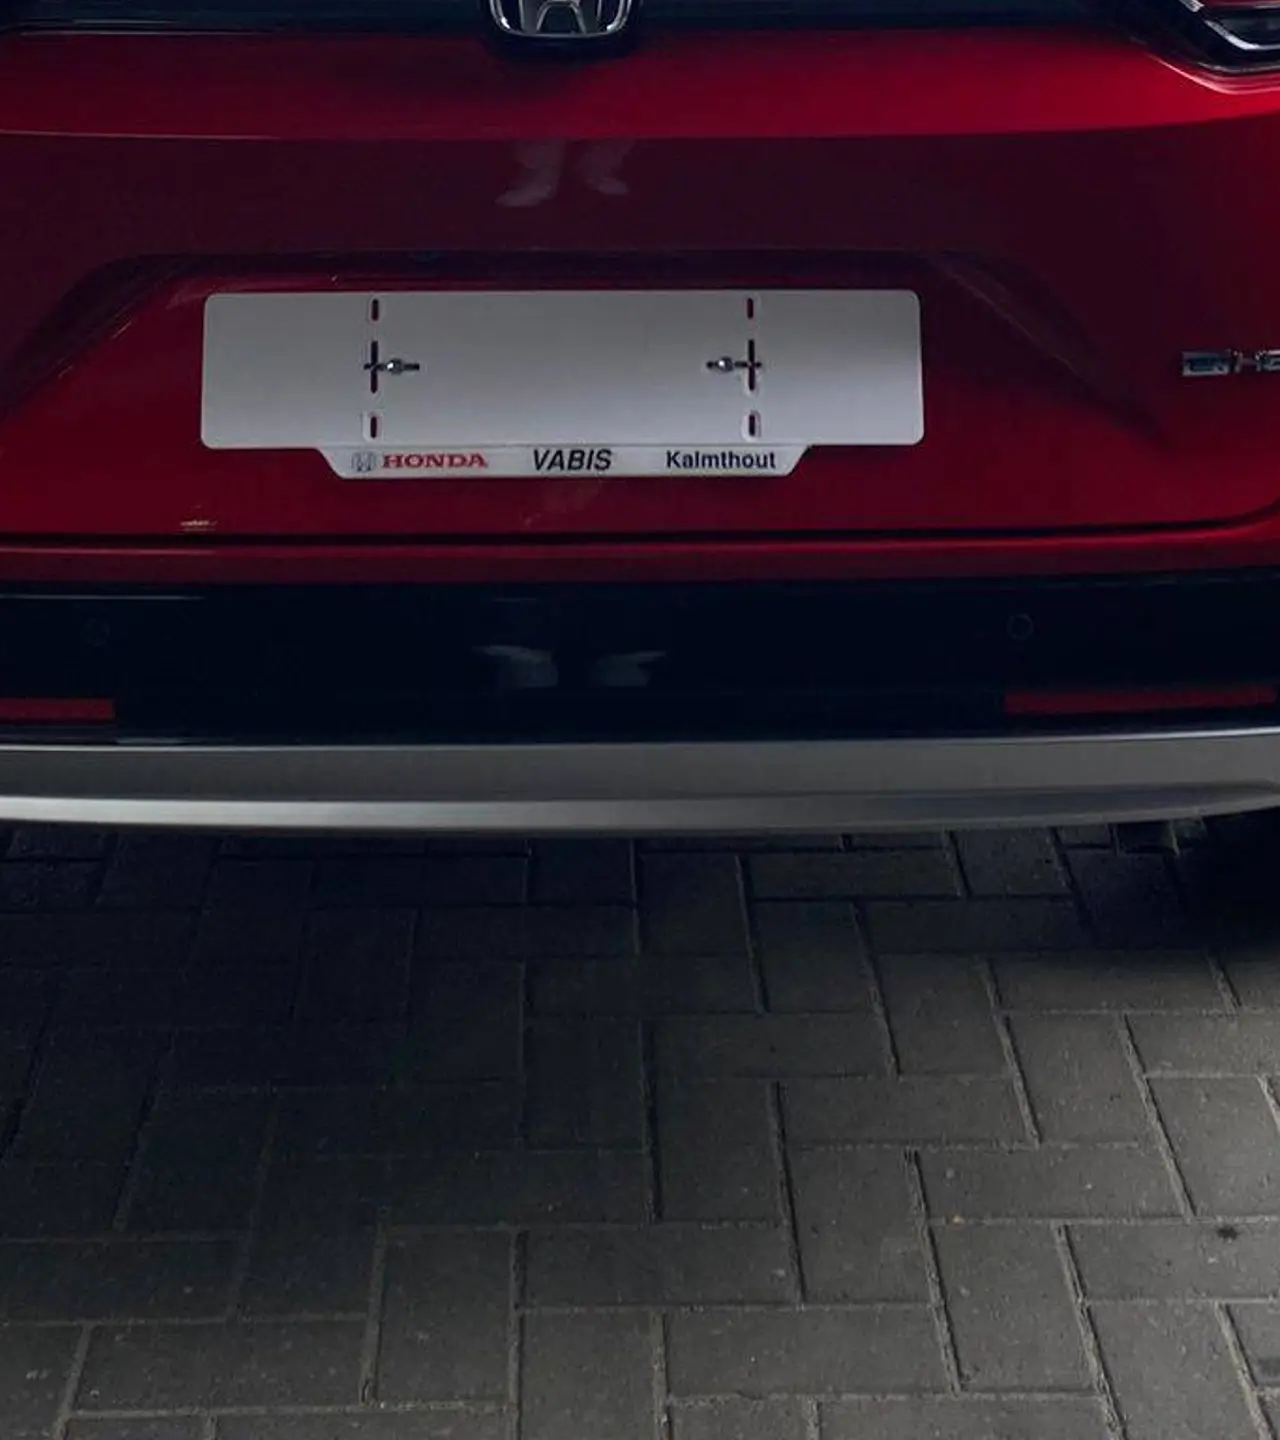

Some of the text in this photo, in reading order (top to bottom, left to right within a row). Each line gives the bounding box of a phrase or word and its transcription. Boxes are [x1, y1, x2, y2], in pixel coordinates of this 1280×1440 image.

[381, 449, 777, 472] HONDA VABIS Kalmthout
